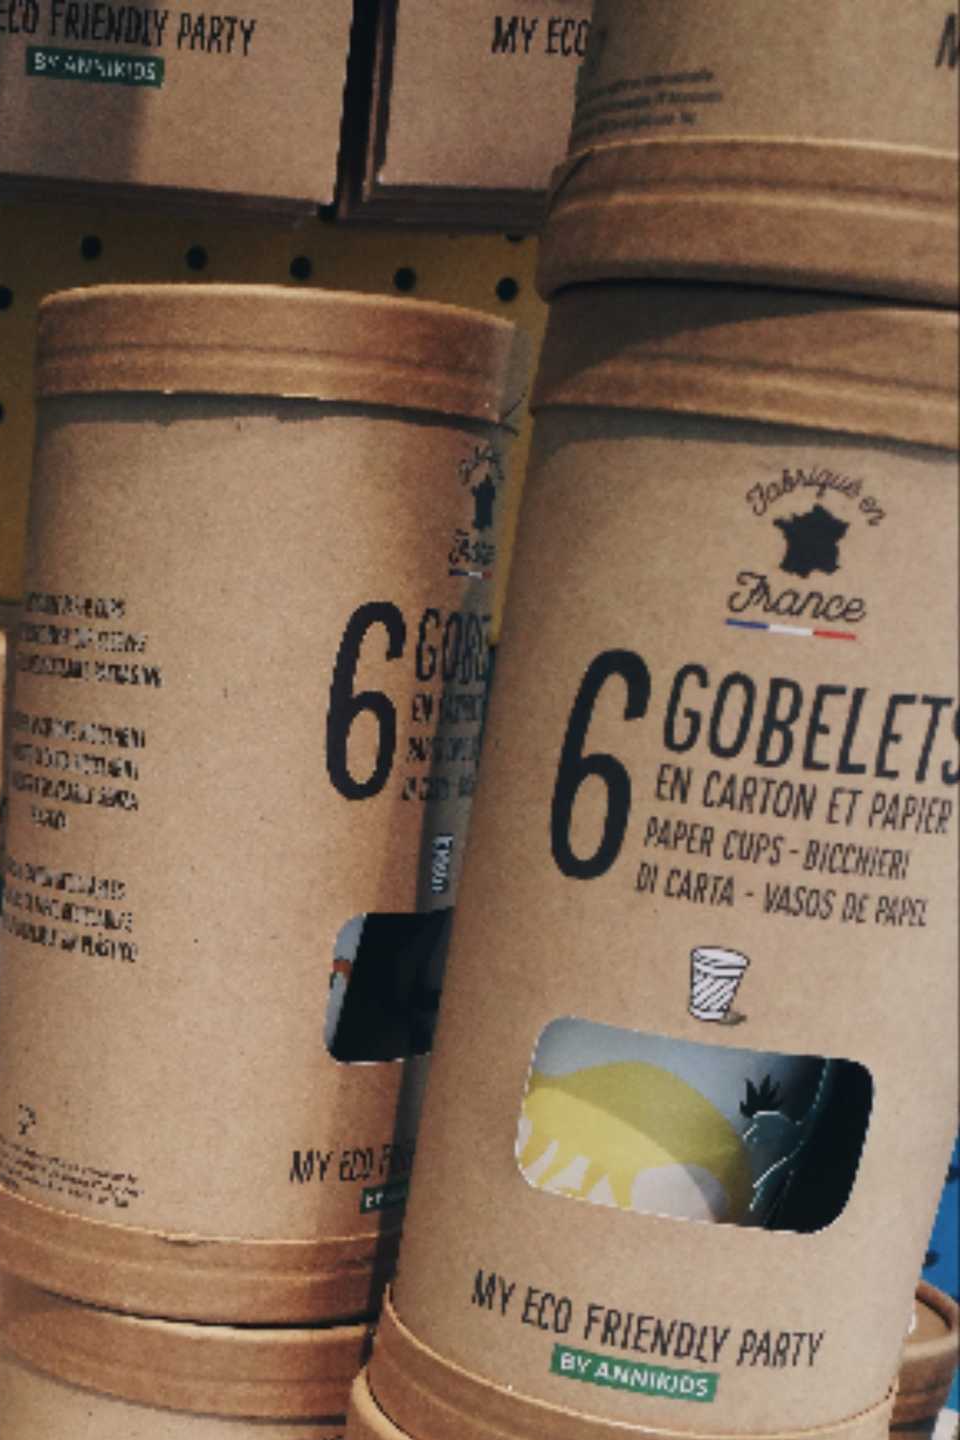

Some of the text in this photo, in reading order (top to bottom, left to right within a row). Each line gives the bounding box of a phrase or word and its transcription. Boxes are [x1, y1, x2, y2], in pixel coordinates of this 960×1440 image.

[51, 2, 168, 47] FRIENDLY
[176, 12, 256, 57] PARTY
[492, 16, 538, 54] MY
[726, 571, 868, 623] France
[325, 602, 407, 800] 6
[551, 649, 652, 880] 6
[655, 763, 954, 836] EN CARTON ET PAPIER
[643, 816, 715, 860] PAPER
[722, 830, 784, 867] CUPS
[803, 838, 910, 881] BICCHIERI
[634, 862, 659, 894] DI
[663, 867, 736, 908] CARTA
[763, 882, 835, 922] VASOS
[841, 892, 867, 925] DE
[471, 1269, 825, 1369] MY ECO FRIENDLY PARTY
[559, 1354, 709, 1398] BY ANNIKIDS
